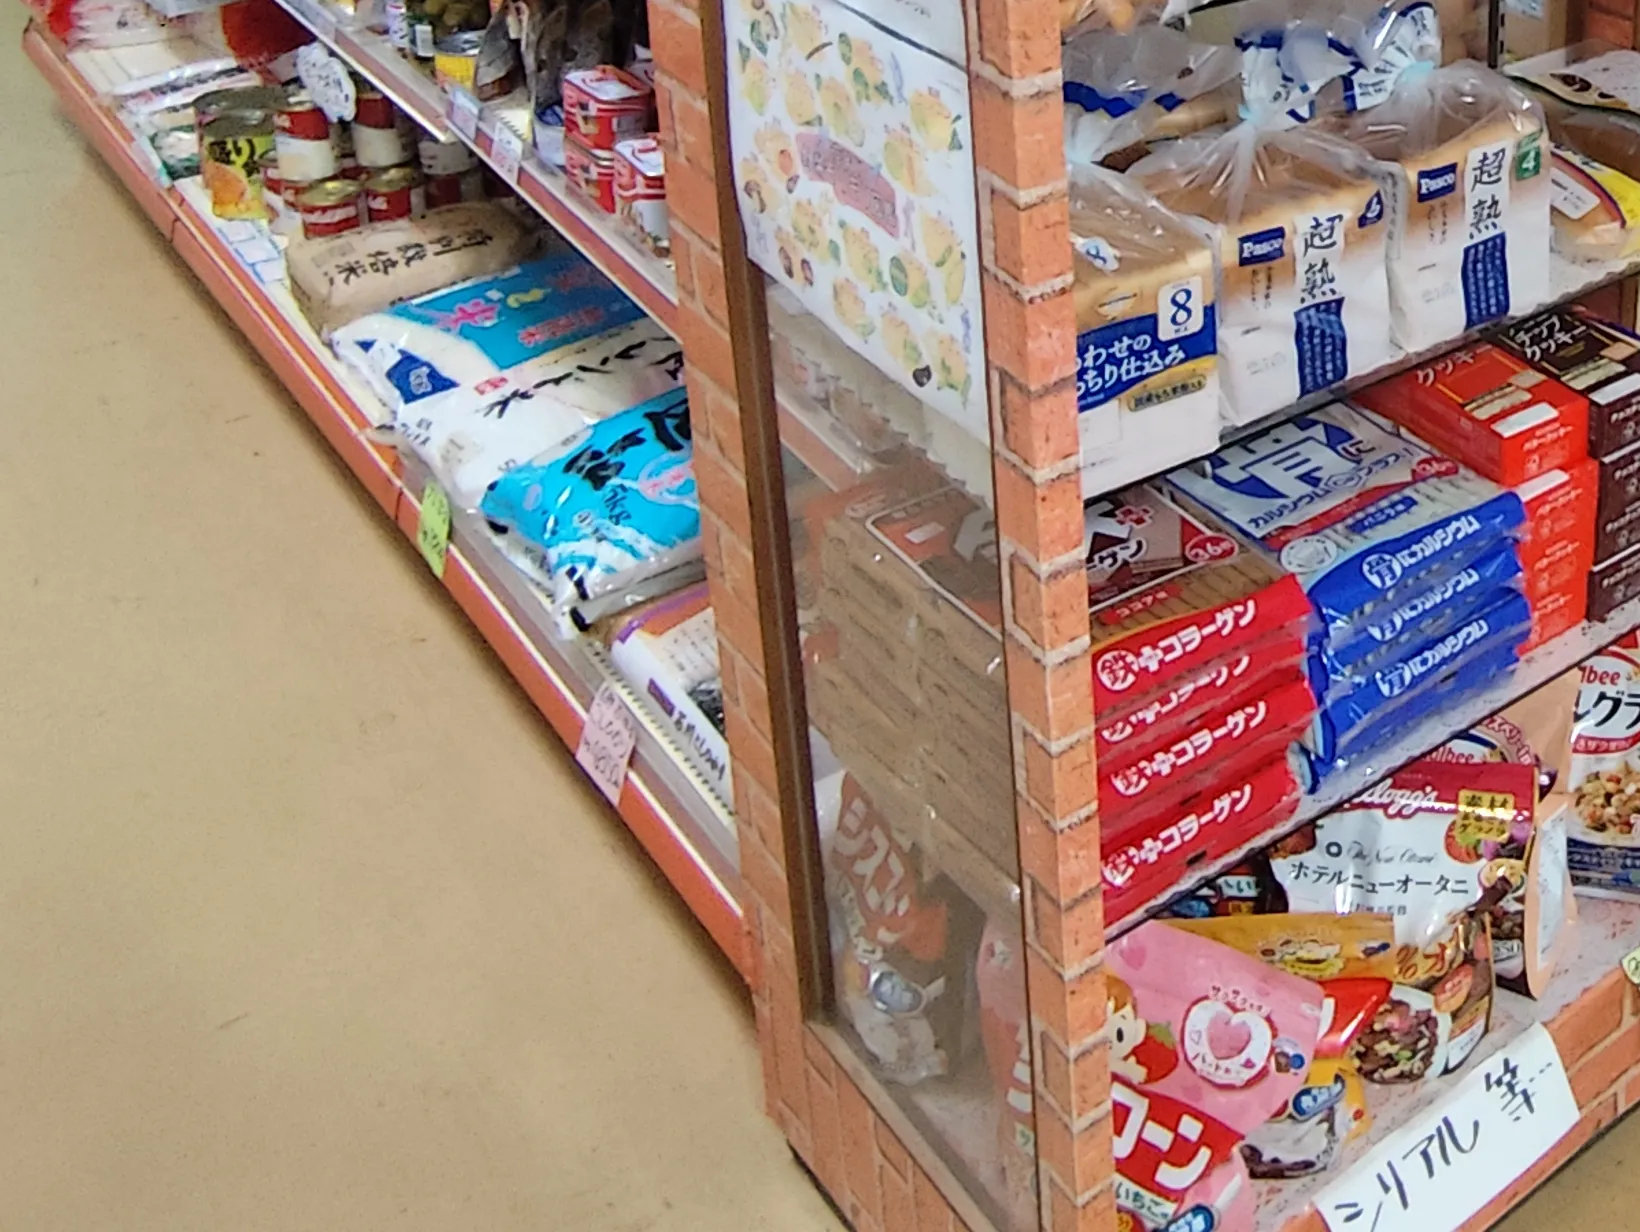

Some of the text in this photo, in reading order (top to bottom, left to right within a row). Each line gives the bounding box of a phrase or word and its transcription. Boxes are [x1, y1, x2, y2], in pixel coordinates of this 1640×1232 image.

[1521, 154, 1538, 173] 4
[1468, 147, 1507, 240] 超熟
[1242, 237, 1283, 259] Pasco
[1301, 213, 1344, 304] 超熟
[1170, 288, 1193, 326] 8
[1077, 334, 1152, 369] わせの
[1289, 861, 1470, 896] ホテルニューオータニ
